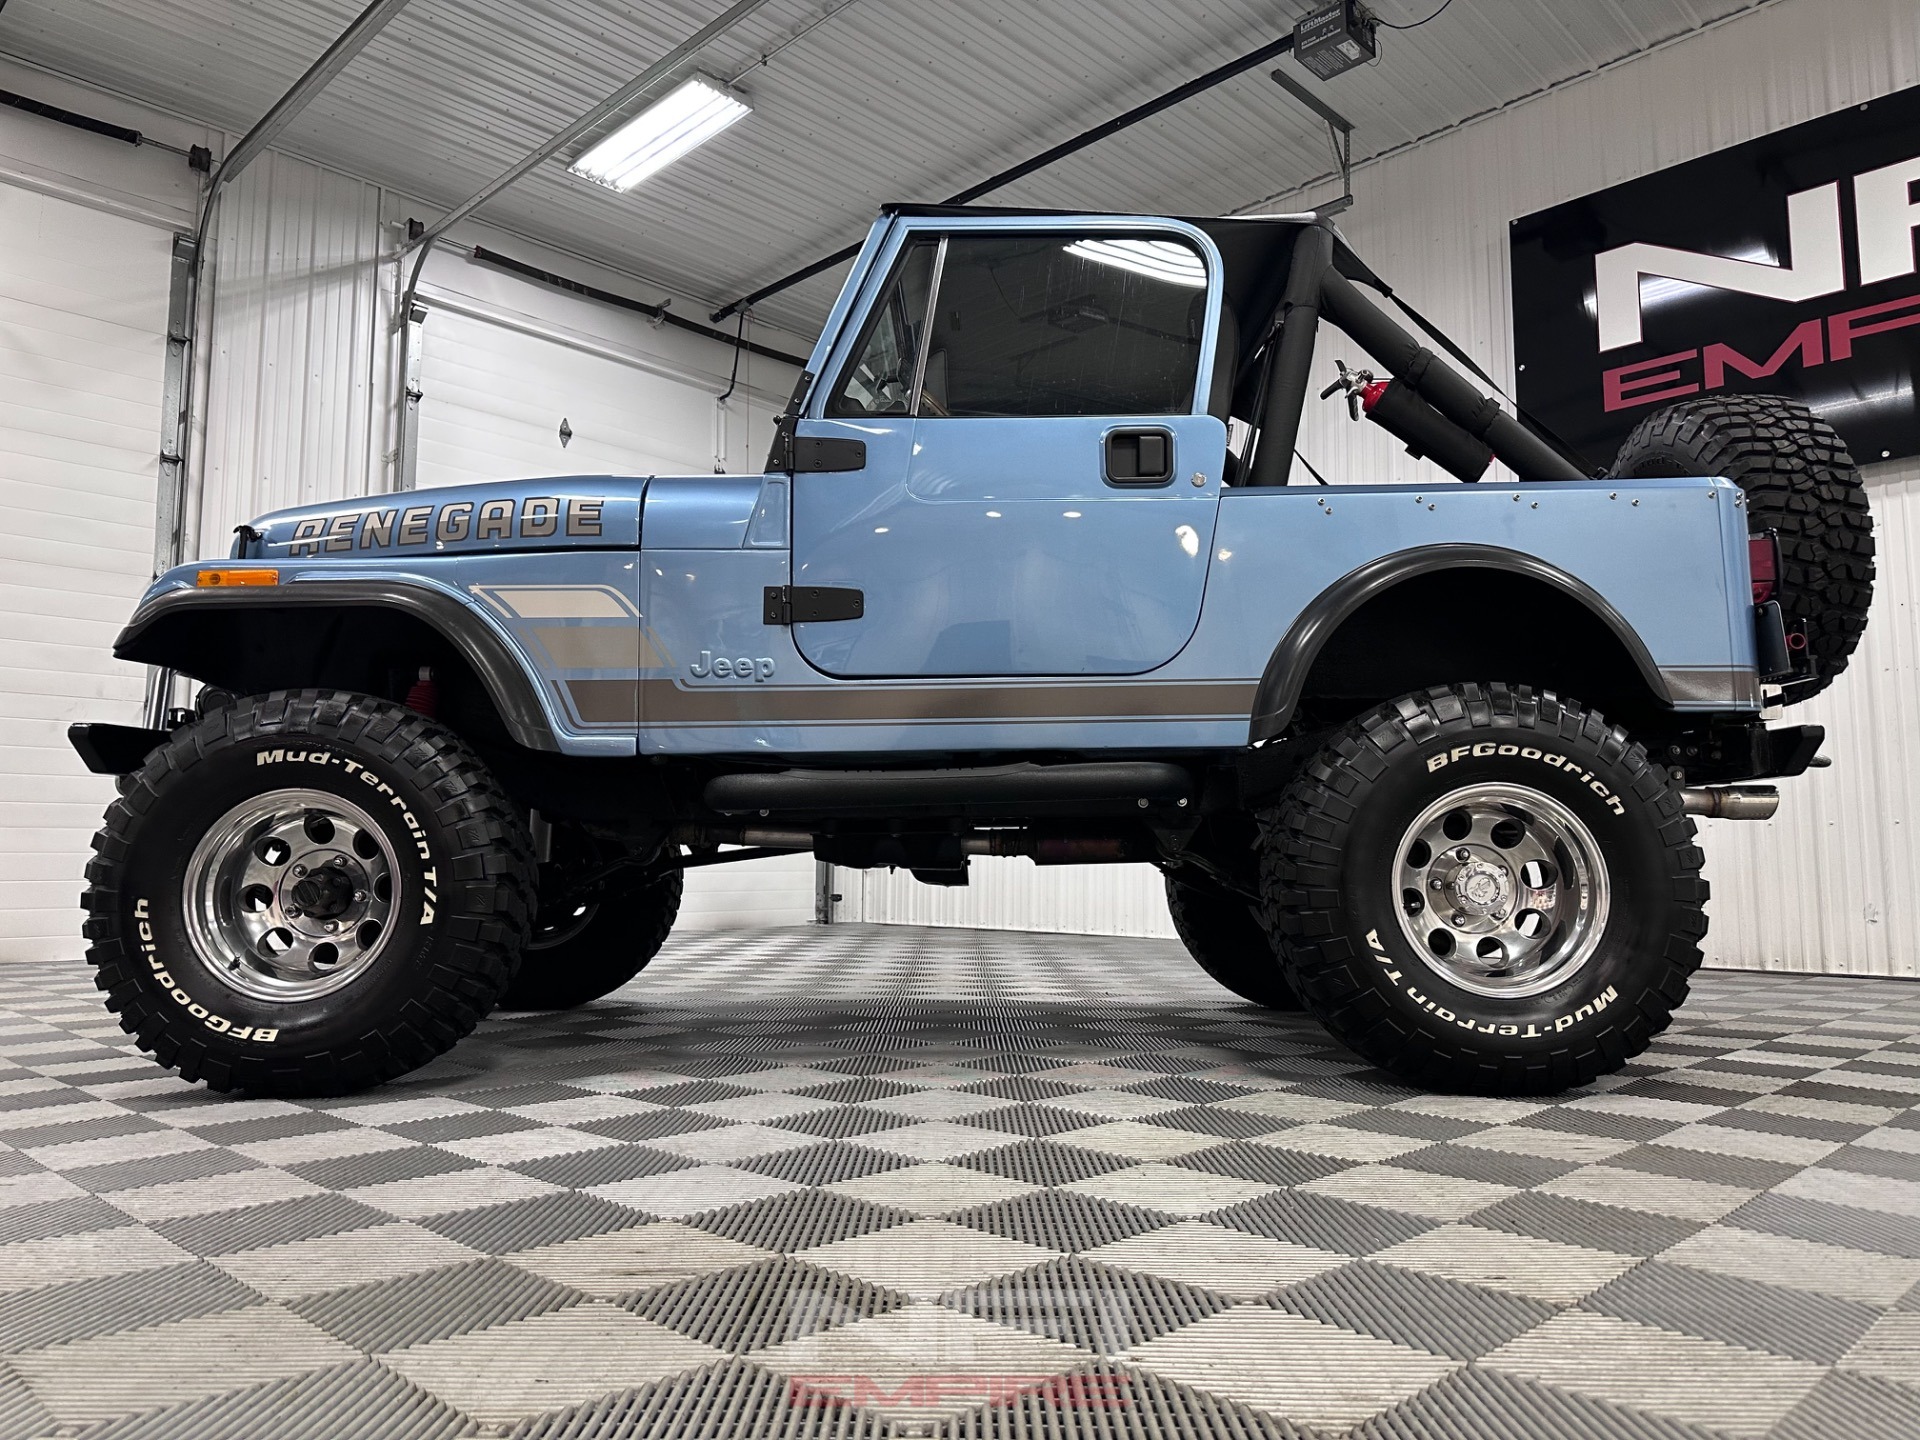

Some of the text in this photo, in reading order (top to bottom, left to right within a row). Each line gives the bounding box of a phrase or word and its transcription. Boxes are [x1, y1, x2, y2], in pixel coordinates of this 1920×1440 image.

[289, 496, 605, 556] RENEGADE
[690, 650, 776, 683] Jeep
[1426, 742, 1626, 816] BFGoodrich
[255, 748, 431, 861] Mud-Terrain
[419, 866, 438, 926] T/A
[133, 897, 280, 1043] BFGoodrich
[1405, 984, 1620, 1040] Mud-Terrain
